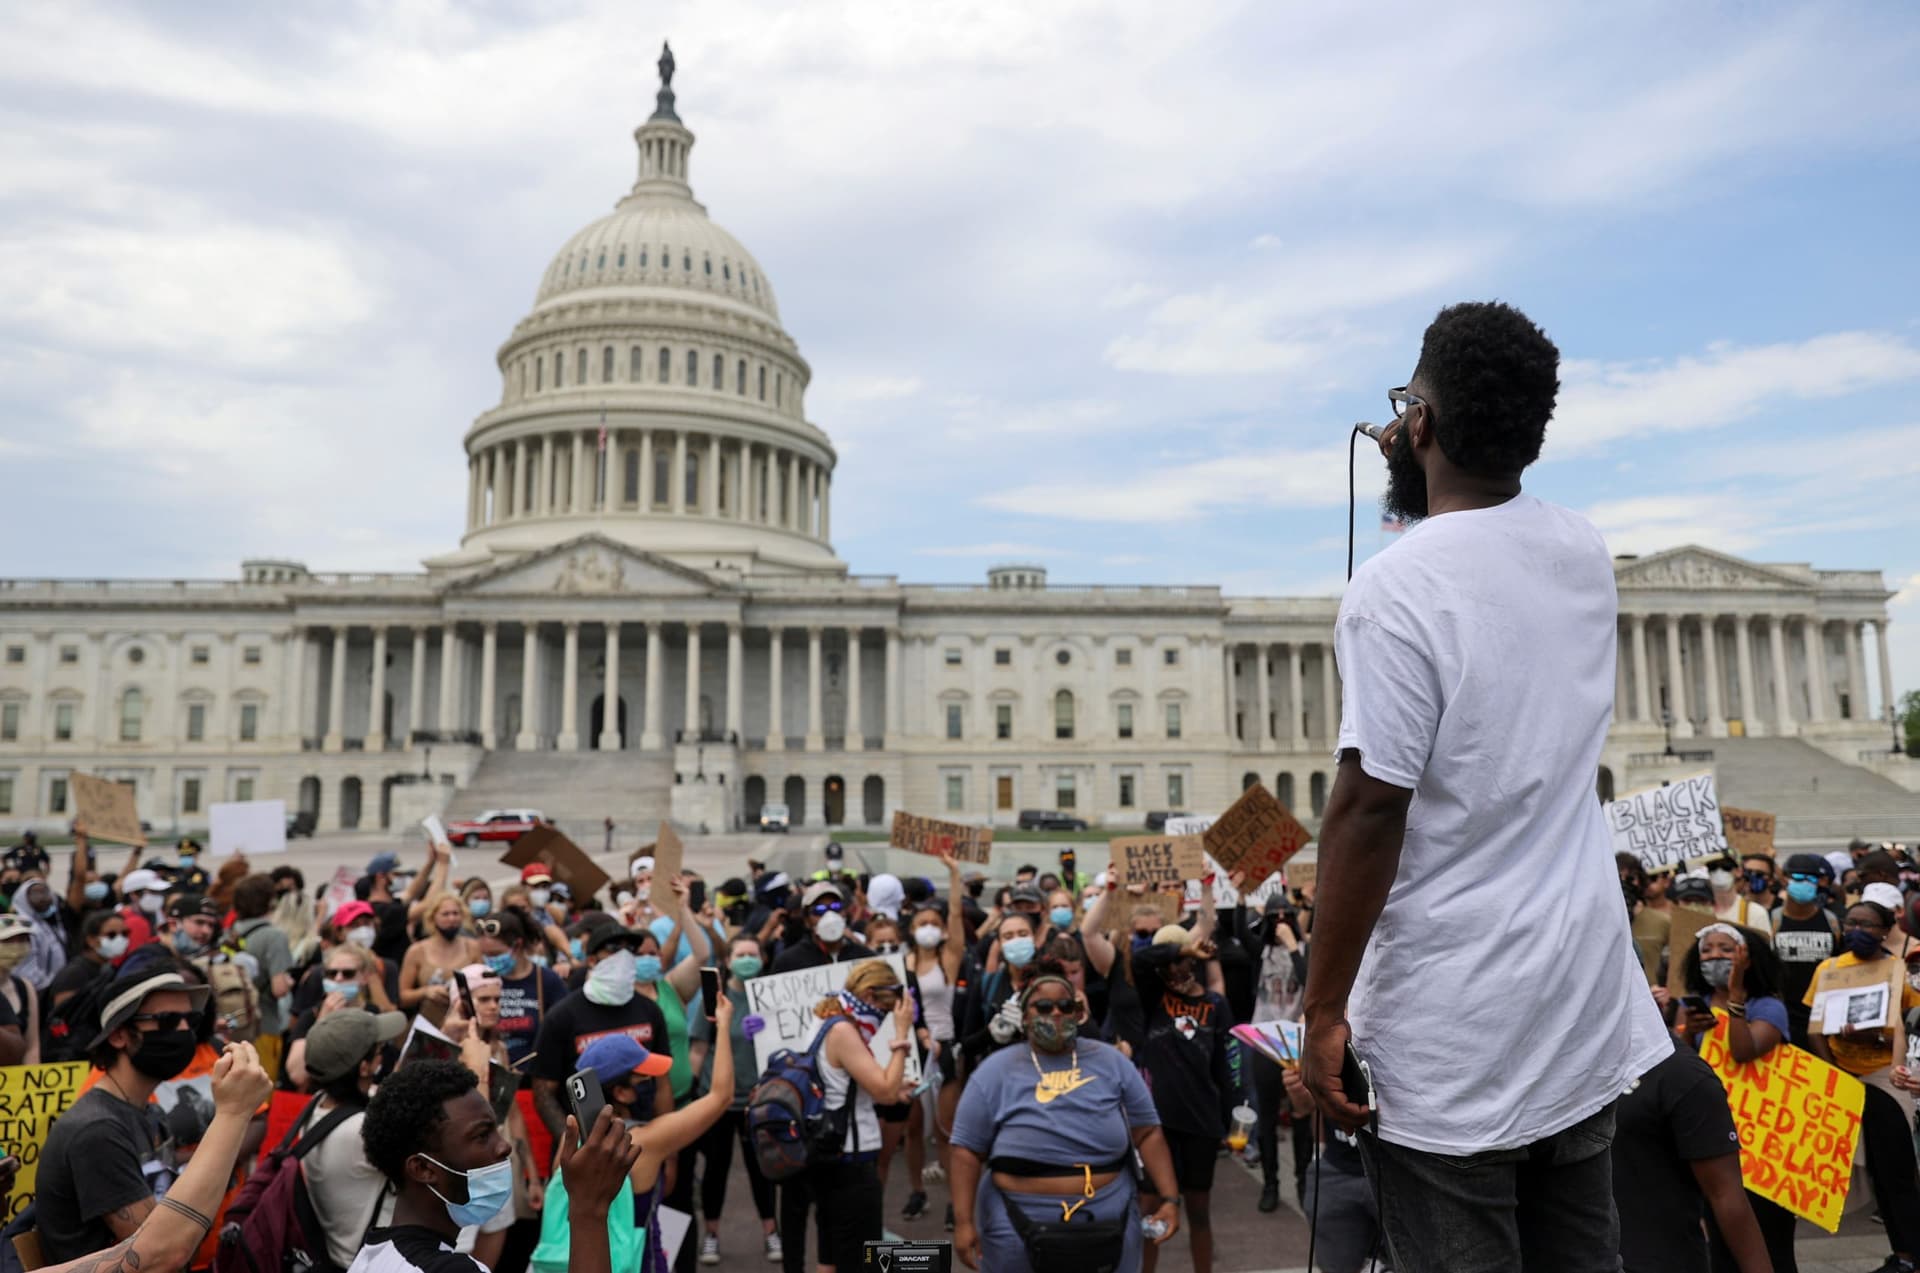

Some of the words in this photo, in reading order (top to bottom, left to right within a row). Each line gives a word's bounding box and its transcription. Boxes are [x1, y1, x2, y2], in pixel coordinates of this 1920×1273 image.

[1611, 776, 1716, 832] BLACK
[1628, 813, 1717, 850] LIVES
[1725, 812, 1770, 834] POLICE
[1125, 843, 1173, 859] BLACK
[1128, 857, 1173, 870] LIVES
[1640, 834, 1728, 869] ATTER
[1126, 869, 1180, 882] MATTER
[23, 1065, 80, 1090] NOT
[1041, 1068, 1082, 1088] NIKE
[1825, 1068, 1839, 1098] I
[1803, 1092, 1862, 1139] GET
[1799, 1121, 1852, 1168] FOR
[1761, 1132, 1849, 1198] BLACK
[1740, 1148, 1828, 1219] ODAY!
